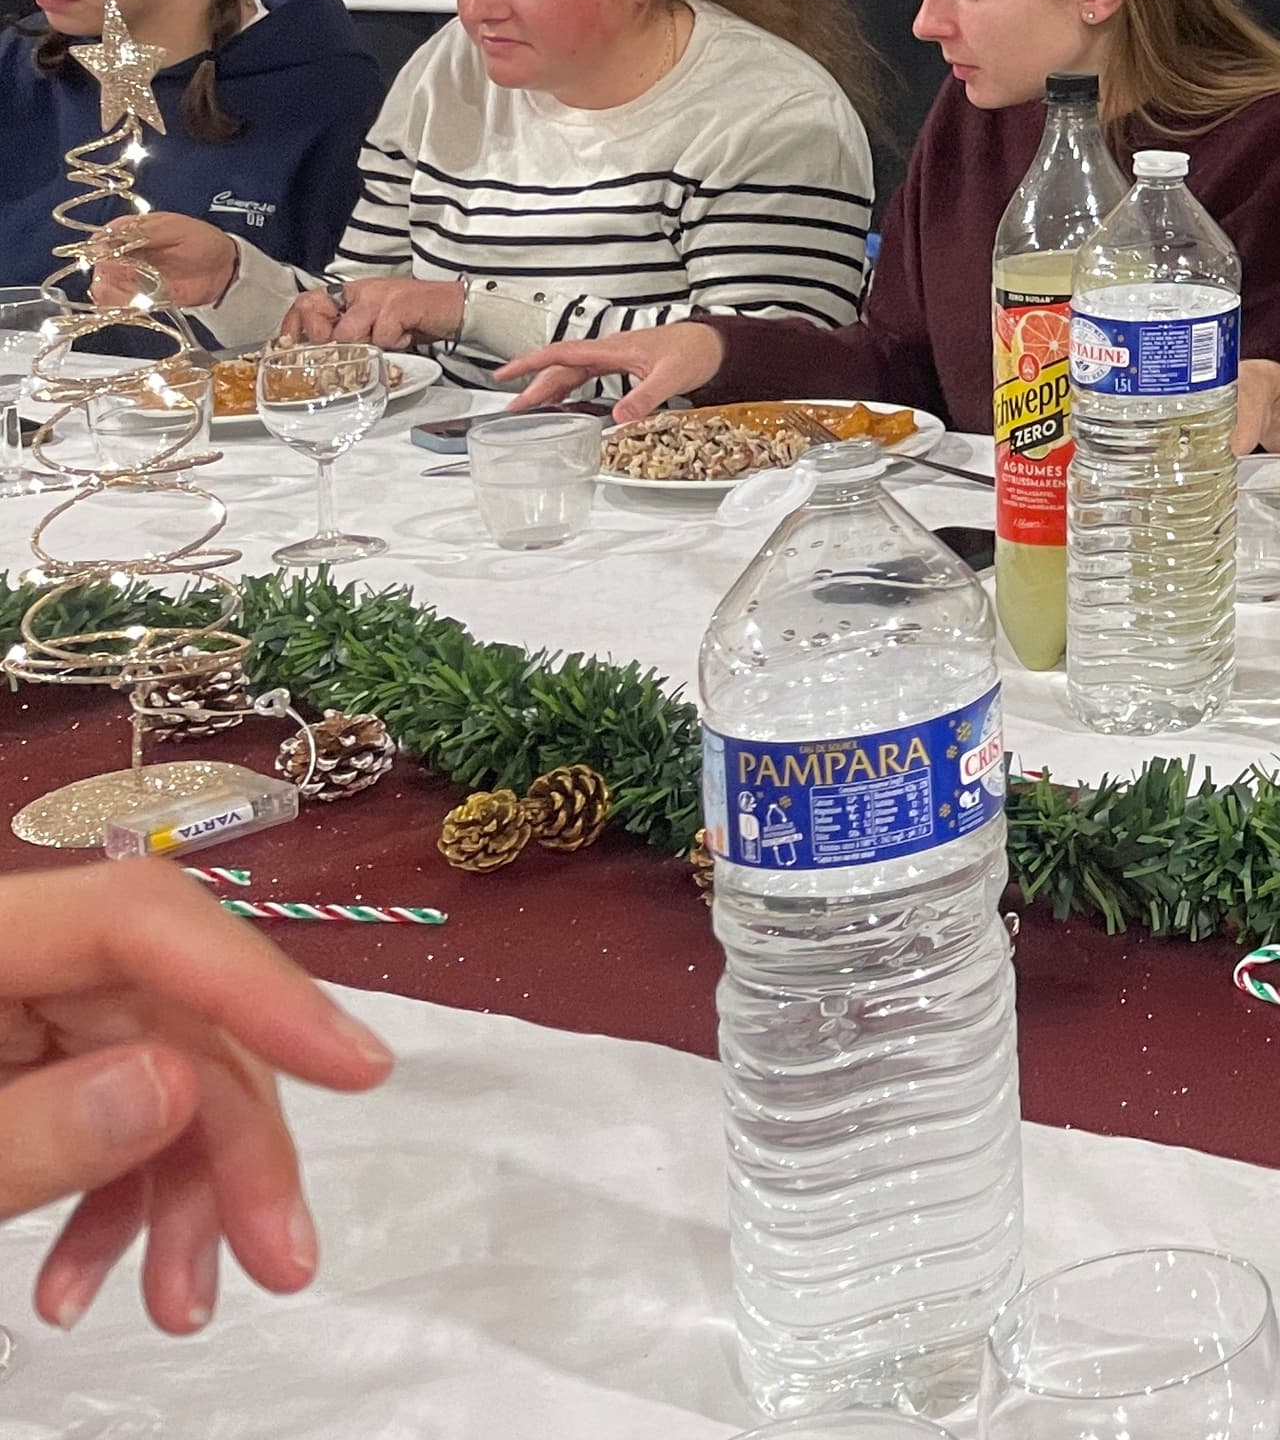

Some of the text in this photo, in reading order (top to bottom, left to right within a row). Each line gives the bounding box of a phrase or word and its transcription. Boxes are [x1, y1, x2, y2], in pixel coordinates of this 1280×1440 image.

[1071, 341, 1127, 364] STALINE
[995, 373, 1070, 426] chwepp
[1014, 418, 1057, 448] ZERO
[1003, 460, 1063, 478] AGRUMES
[738, 736, 931, 787] PAMPARA
[965, 734, 1003, 777] CRIS
[179, 811, 242, 839] VARTA
